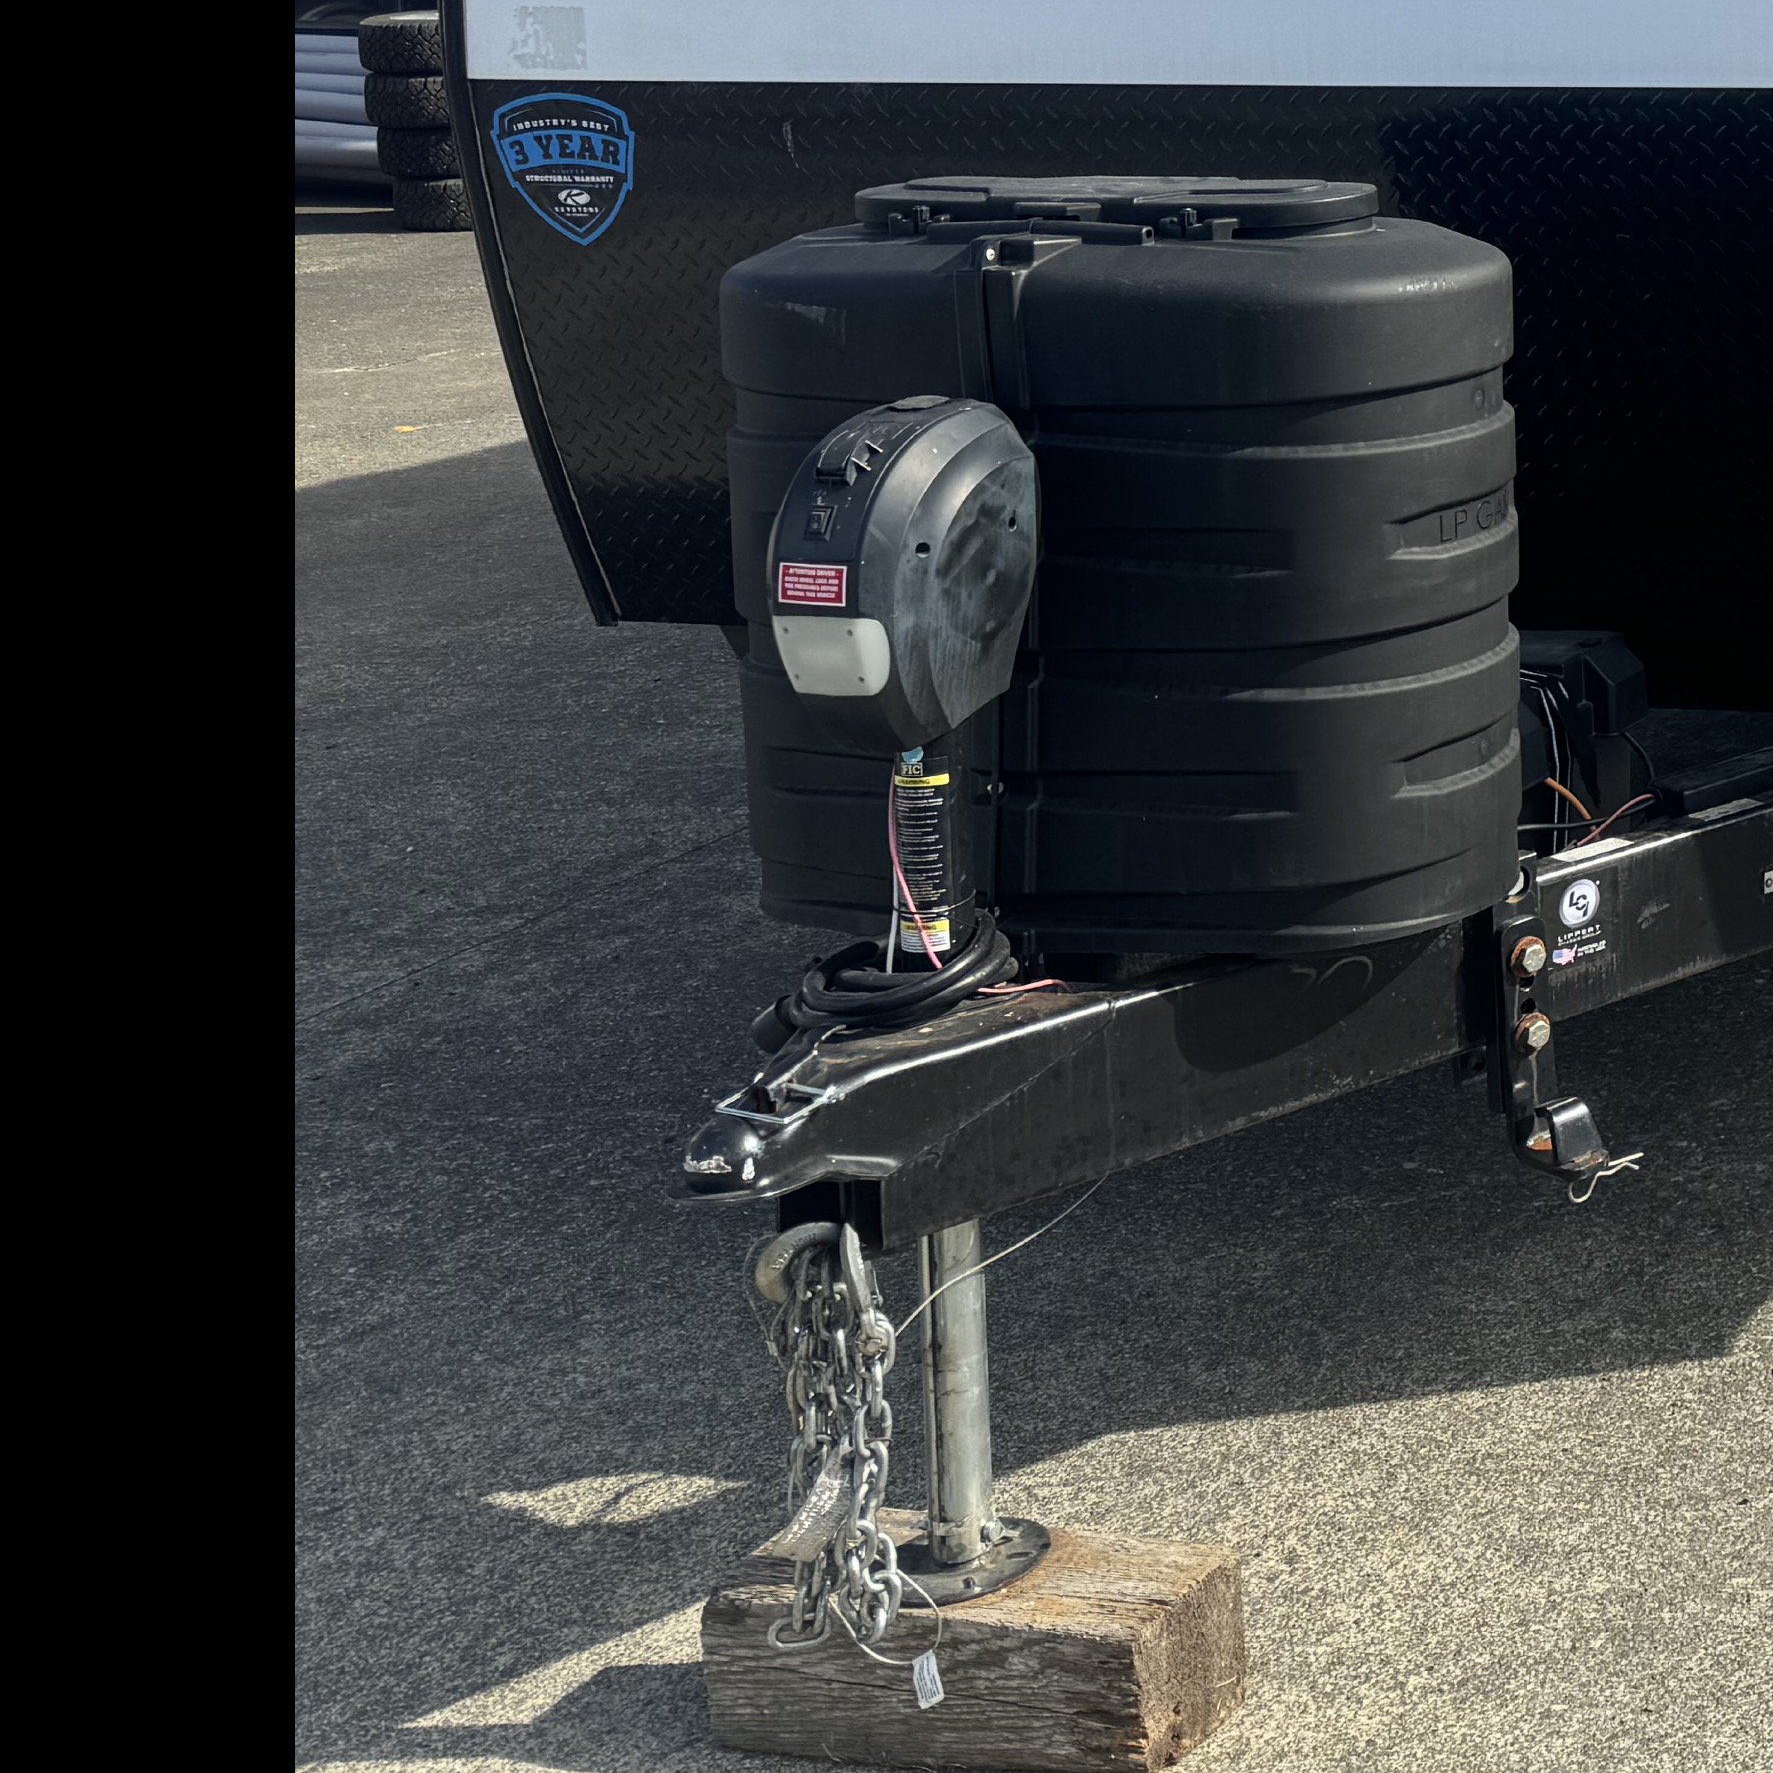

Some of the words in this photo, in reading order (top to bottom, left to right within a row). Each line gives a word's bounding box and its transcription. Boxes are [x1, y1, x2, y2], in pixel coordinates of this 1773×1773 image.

[512, 118, 578, 132] INDUSTRY'S
[508, 140, 530, 165] 3
[533, 133, 621, 166] YEAR
[1440, 509, 1467, 543] LP
[1557, 924, 1602, 943] LIPPERT
